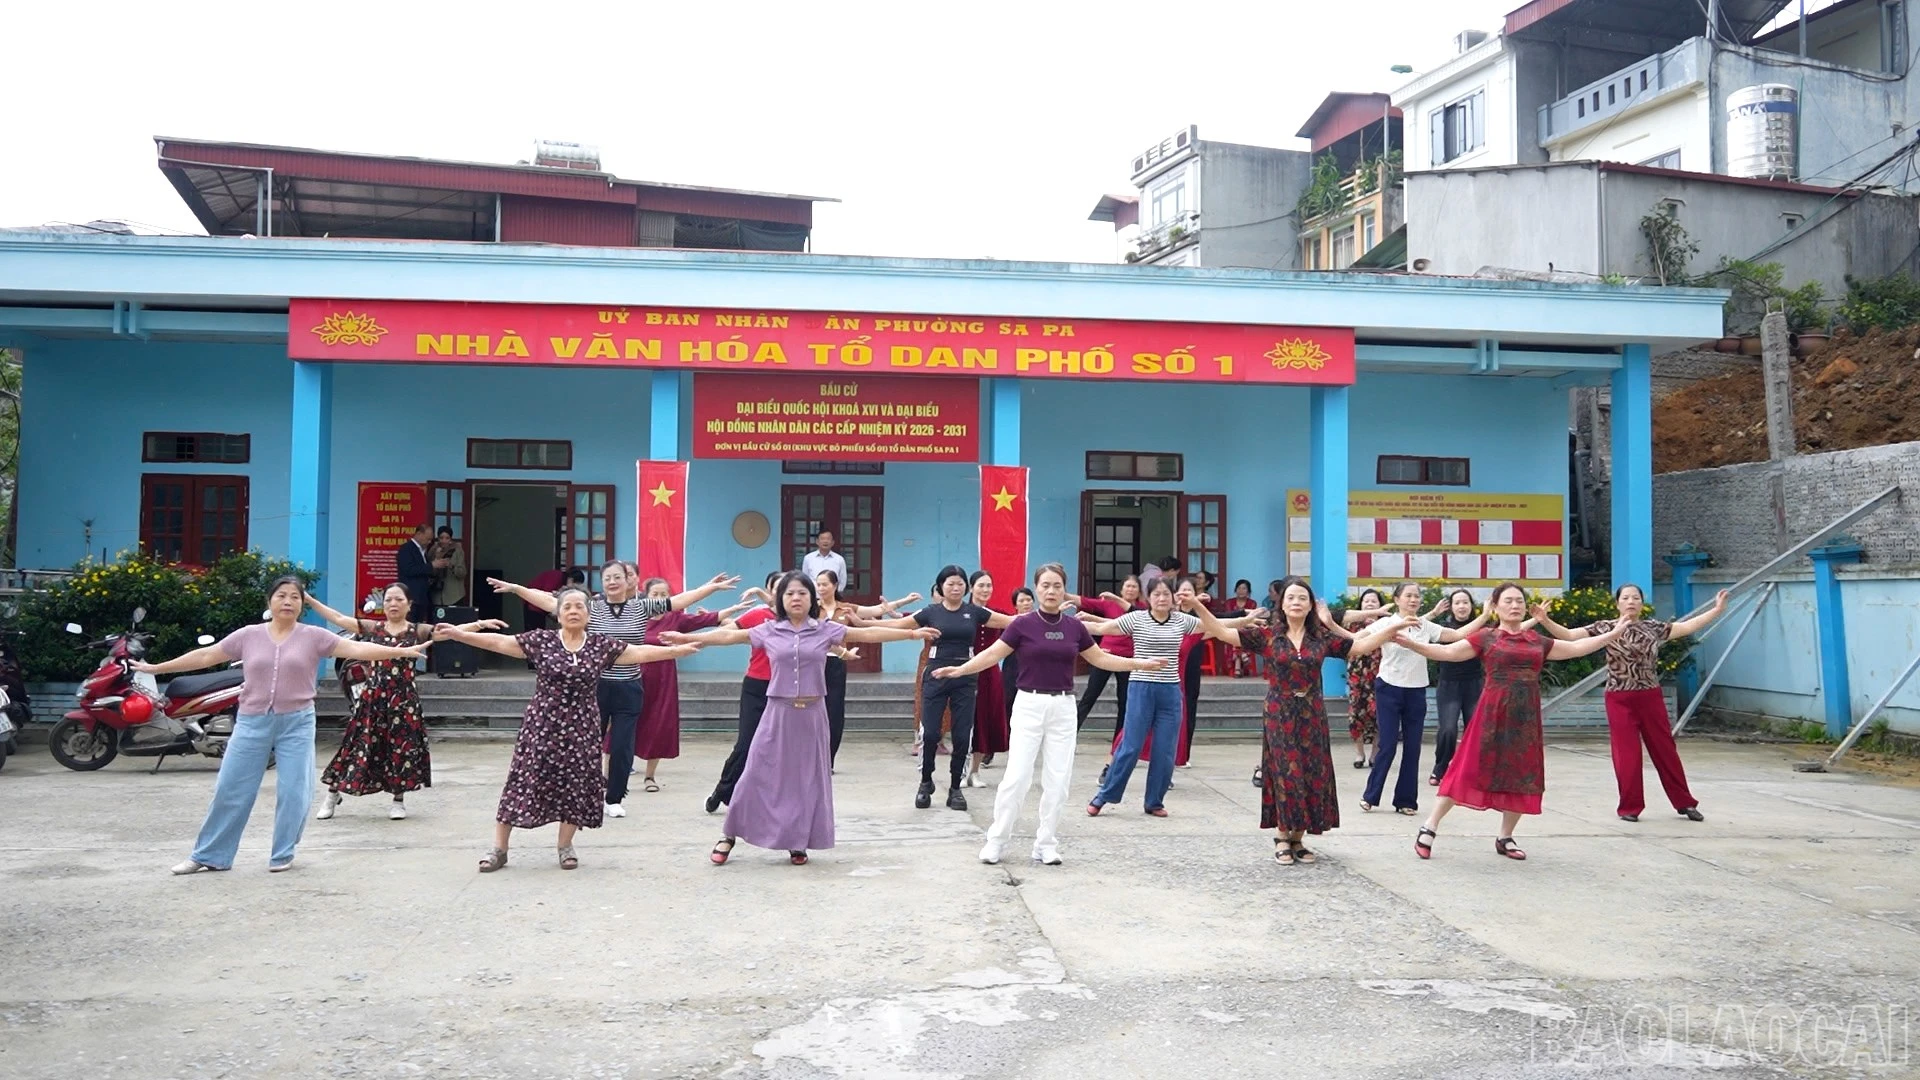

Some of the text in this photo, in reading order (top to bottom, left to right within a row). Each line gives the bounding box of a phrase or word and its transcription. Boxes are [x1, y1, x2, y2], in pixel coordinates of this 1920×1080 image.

[598, 308, 1075, 337] UỶ BAN NHÂN ÂN PHƯỜNG SA PA
[415, 329, 1233, 376] NHÀ VĂN HÓA TỔ DAN PHỐ SỐ 1
[736, 401, 755, 417] ĐẠI
[756, 398, 781, 414] BIỂU
[782, 399, 810, 416] QUỐC
[812, 401, 830, 418] HỘI
[862, 404, 879, 416] XVI
[880, 402, 894, 416] VÀ
[896, 404, 914, 419] ĐẠI
[916, 401, 939, 417] BIỂU
[706, 418, 725, 435] HỘI
[757, 419, 786, 434] NHÂN
[789, 420, 811, 434] DÂN
[812, 420, 834, 434] CÁC
[835, 419, 857, 435] CẤP
[859, 421, 892, 438] NHIỆM
[894, 421, 908, 436] KỲ
[909, 424, 935, 437] 2026
[943, 424, 967, 437] 2031
[933, 446, 944, 454] SA
